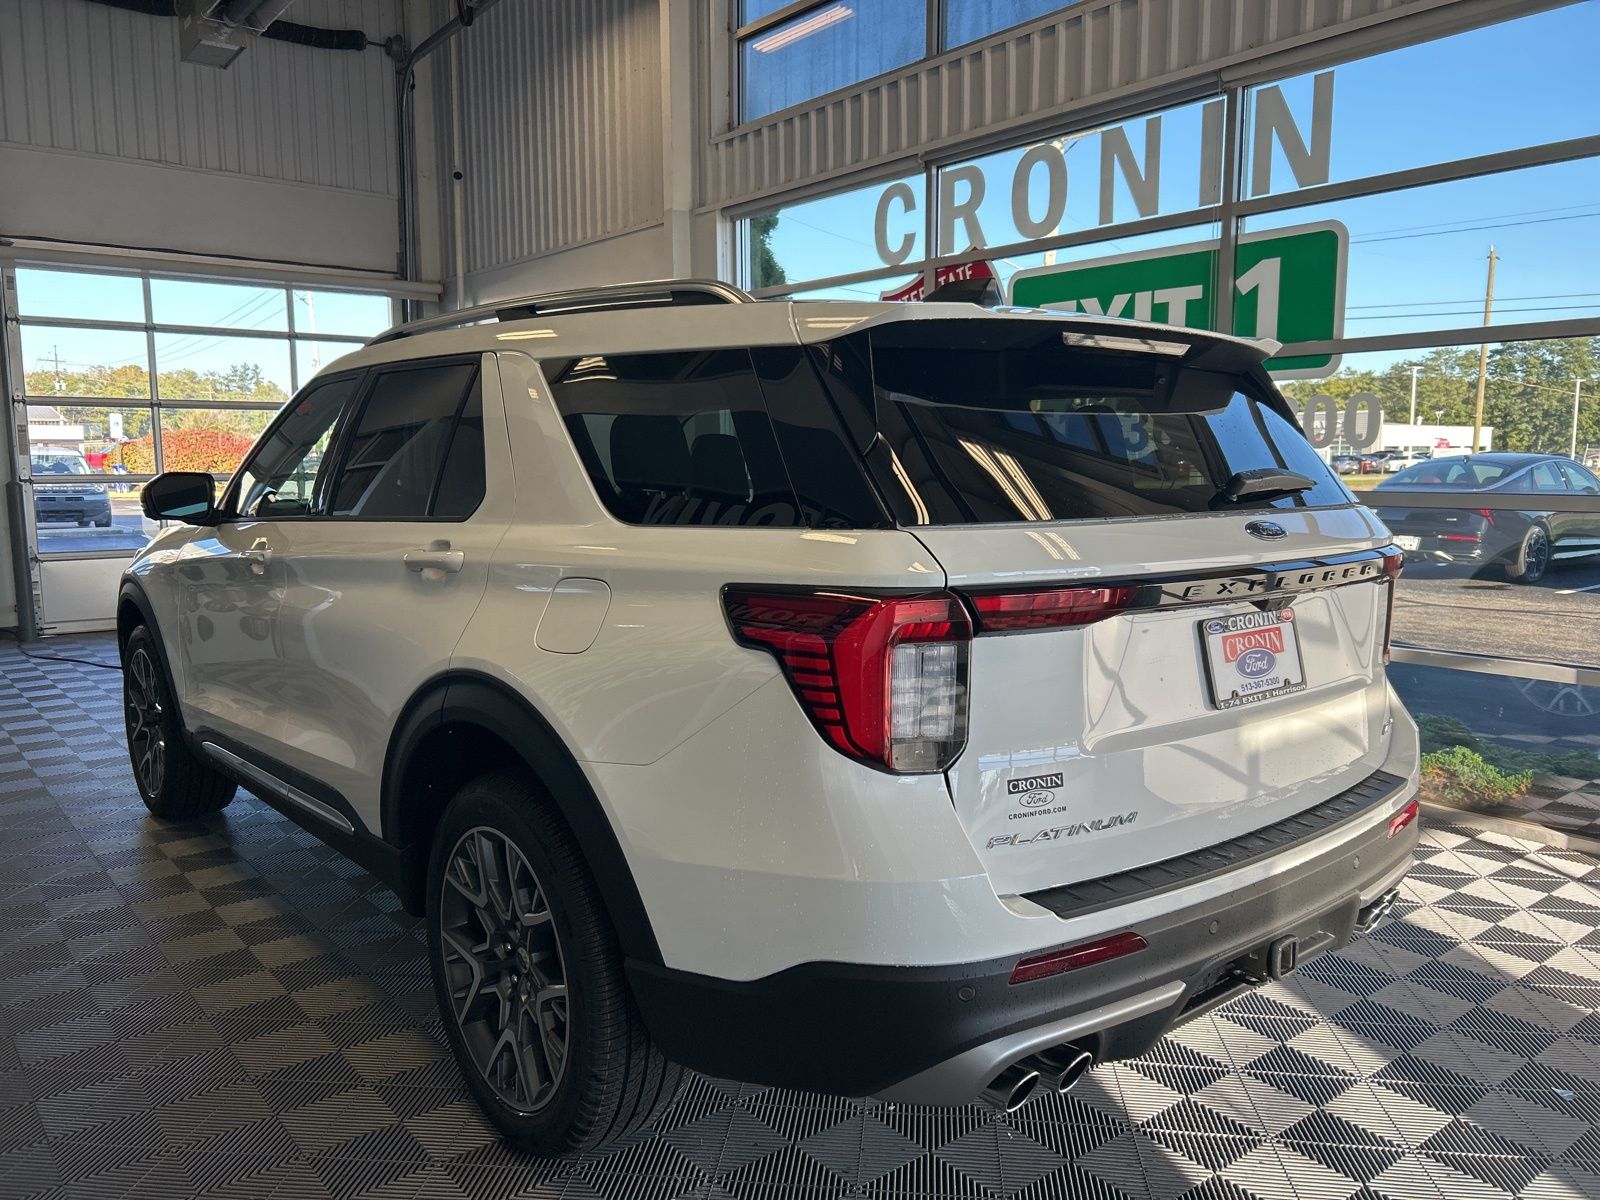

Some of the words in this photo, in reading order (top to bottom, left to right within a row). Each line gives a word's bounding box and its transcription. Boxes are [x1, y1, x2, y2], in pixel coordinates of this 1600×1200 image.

[874, 70, 1335, 266] CRONIN
[1040, 285, 1203, 328] IT
[1235, 257, 1281, 341] 1
[1283, 392, 1383, 449] 00
[1182, 564, 1373, 598] EXPLORER
[1228, 610, 1278, 631] CRONIN
[1226, 630, 1281, 661] CRONIN
[1244, 653, 1269, 673] Ford
[1220, 698, 1241, 709] I-74
[1242, 693, 1263, 704] EXIT
[1272, 684, 1306, 697] Harrison
[1241, 676, 1280, 692] 513-367-5300
[1008, 774, 1063, 792] CRONIN
[1026, 792, 1048, 805] Ford
[1008, 805, 1067, 820] CRONINFORD.COM
[985, 811, 1138, 849] PLATINUM
